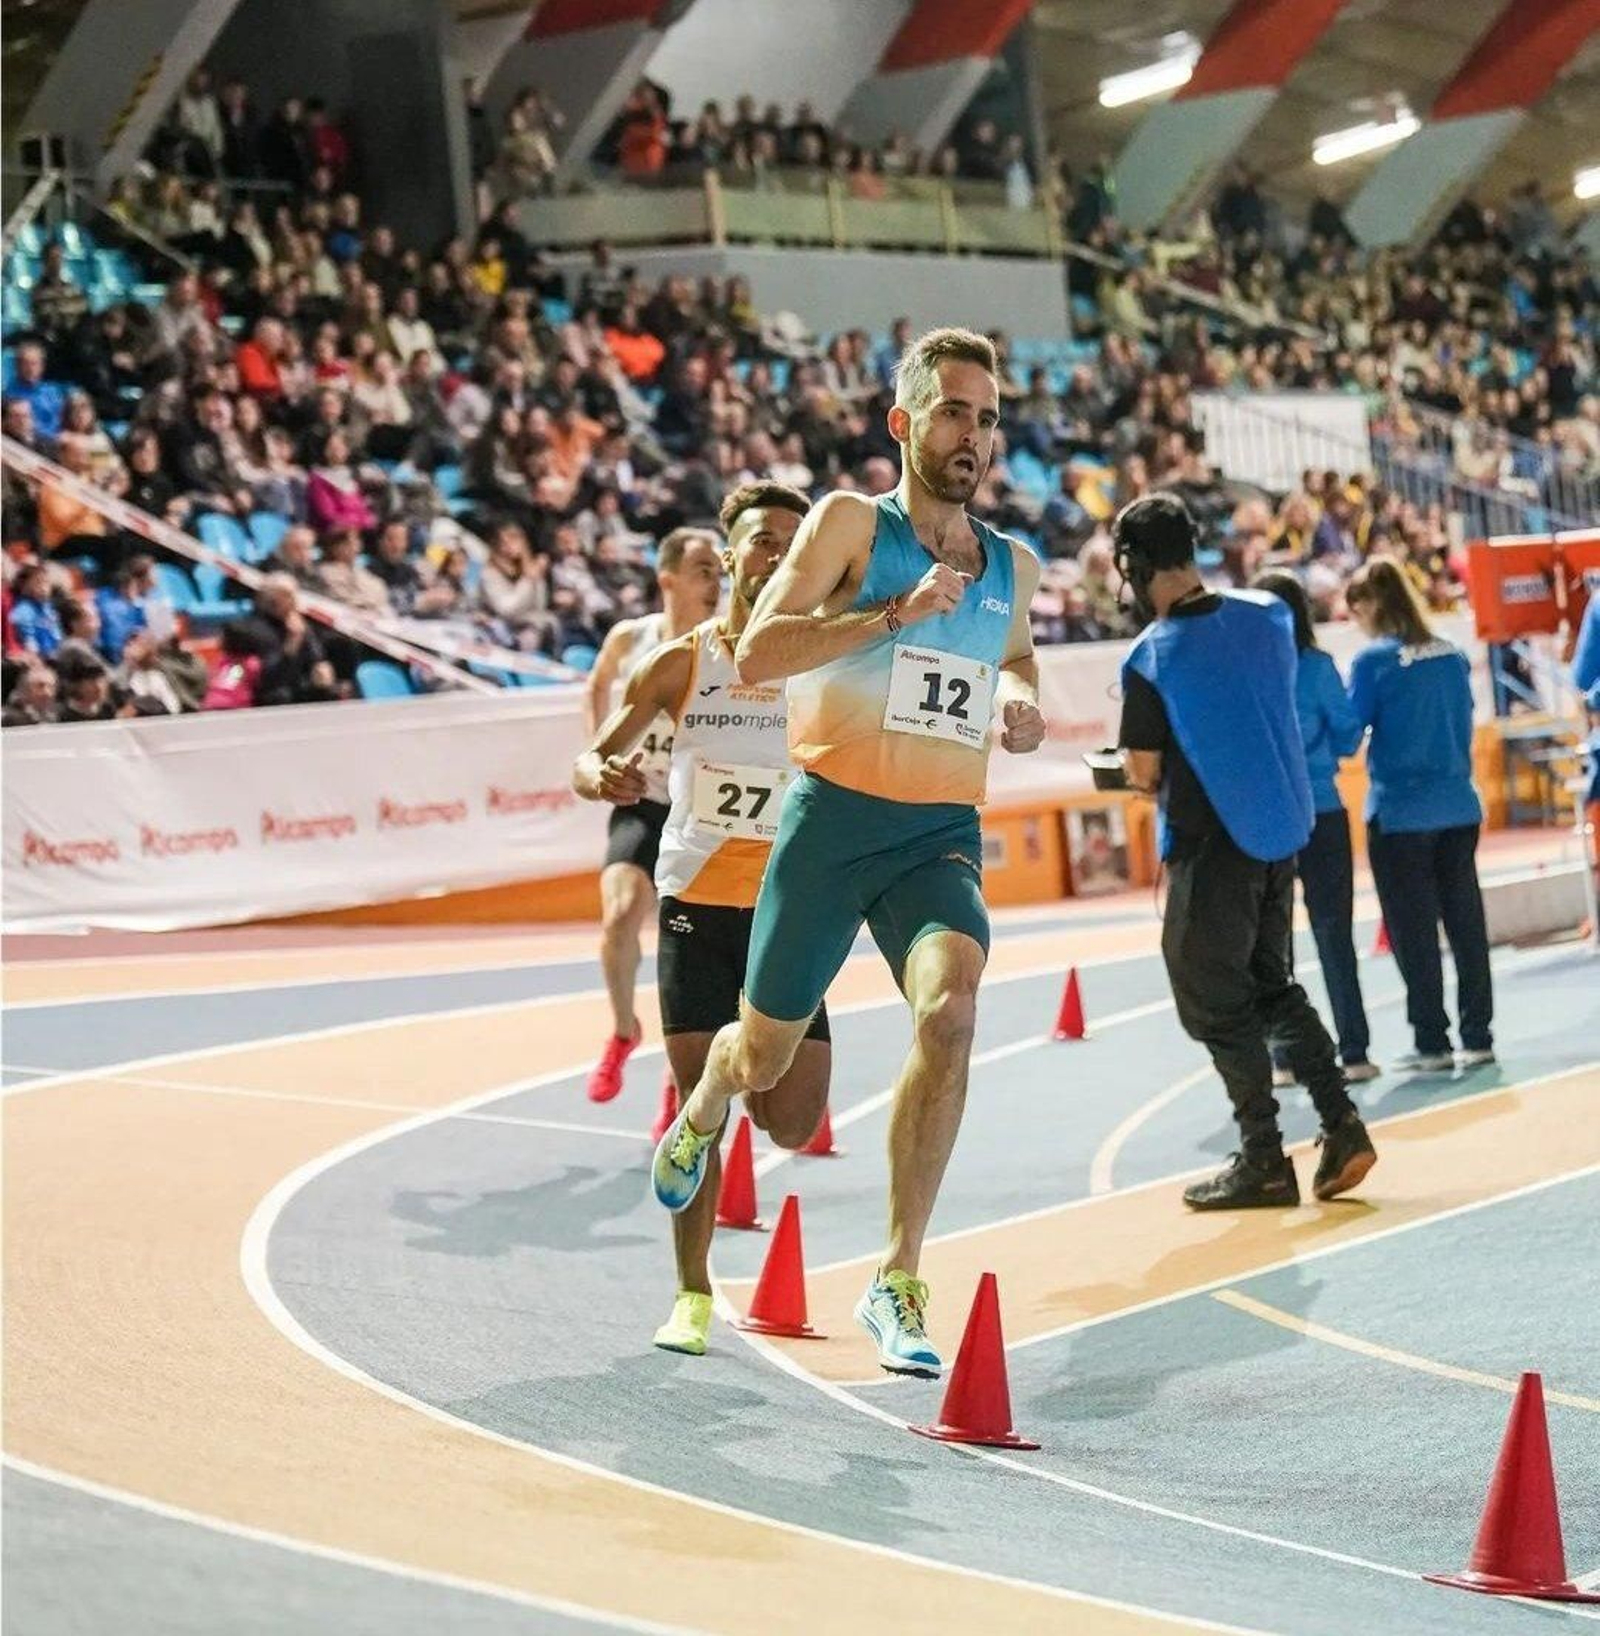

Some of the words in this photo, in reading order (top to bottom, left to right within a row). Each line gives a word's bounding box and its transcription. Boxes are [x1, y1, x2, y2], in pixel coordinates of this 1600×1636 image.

[980, 596, 1010, 616] HOKA
[900, 649, 940, 665] Alcampo
[919, 672, 971, 720] 12
[717, 782, 772, 820] 27
